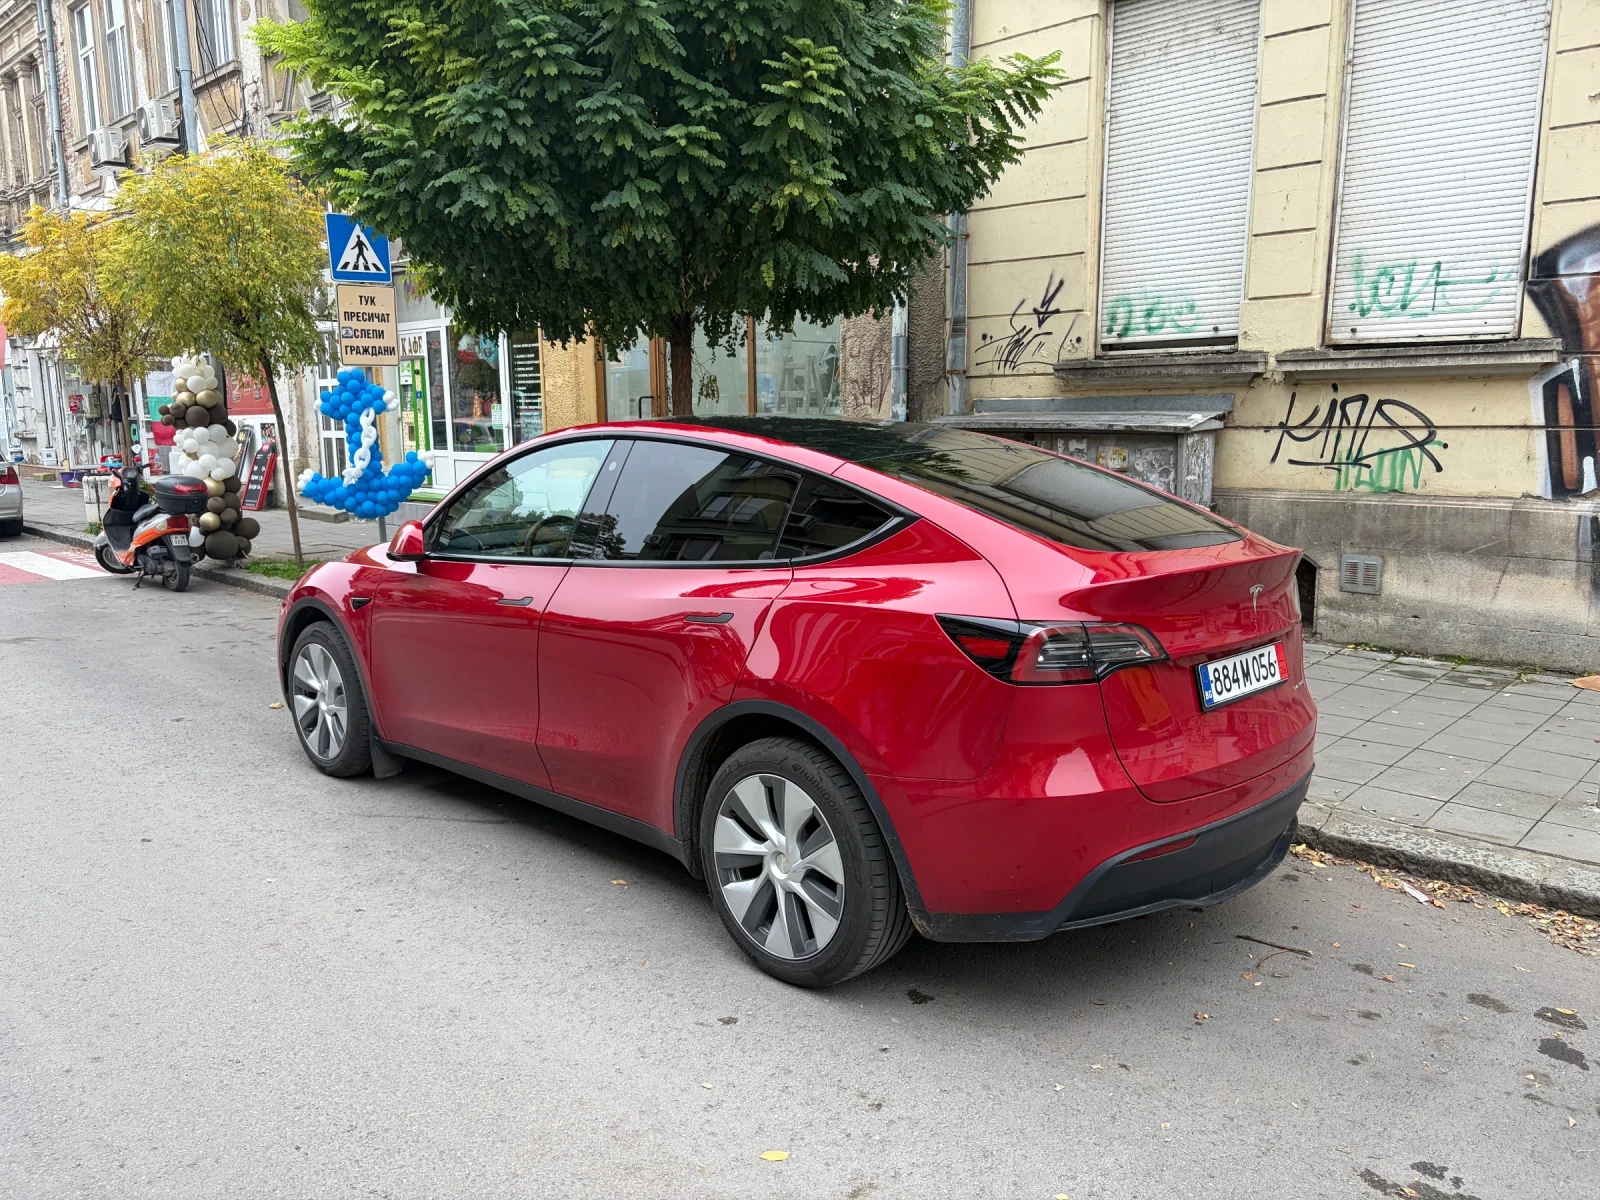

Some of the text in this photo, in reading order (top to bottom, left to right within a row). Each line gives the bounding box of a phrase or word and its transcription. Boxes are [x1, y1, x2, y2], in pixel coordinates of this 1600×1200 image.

[358, 295, 376, 306] ТУК
[344, 311, 390, 323] ПРЕСИЧАТ
[353, 328, 385, 339] СЛЕПИ
[344, 345, 396, 357] ГРАЖДАНИ
[1205, 690, 1213, 700] BG
